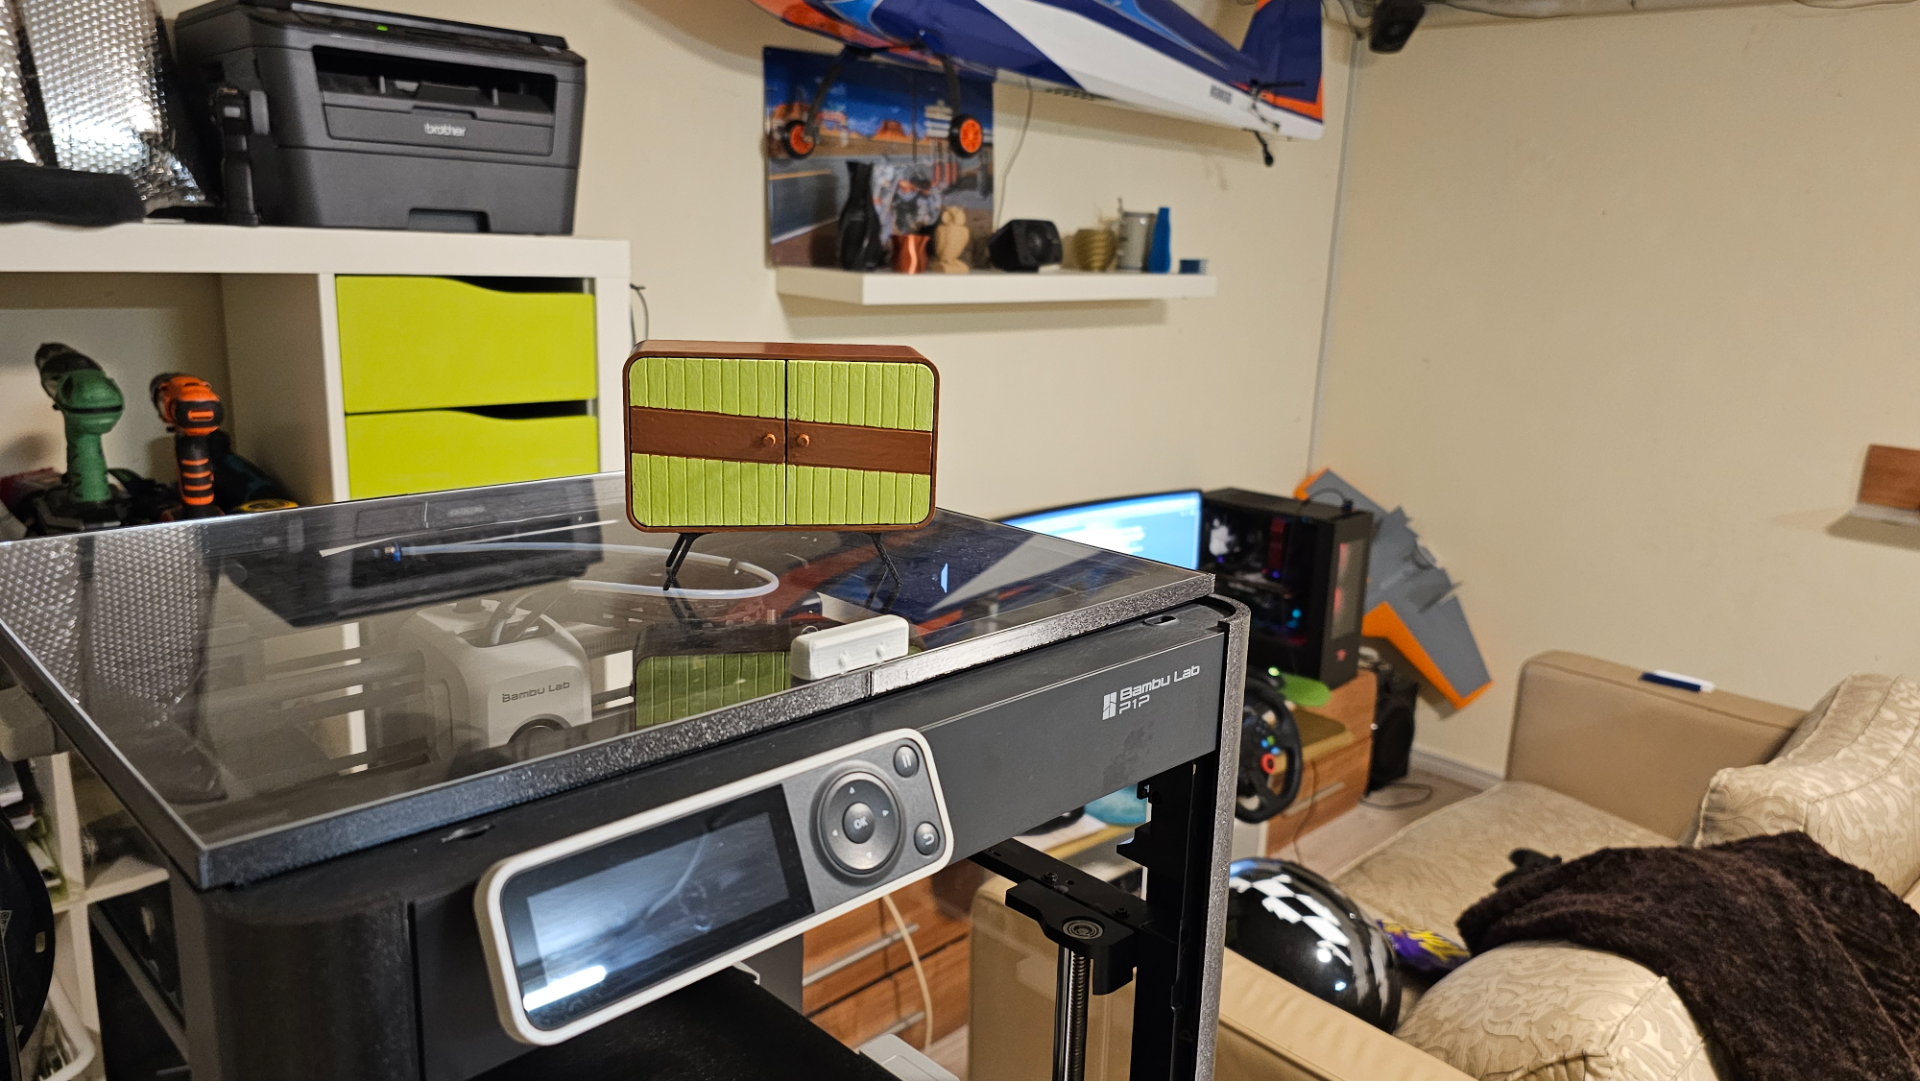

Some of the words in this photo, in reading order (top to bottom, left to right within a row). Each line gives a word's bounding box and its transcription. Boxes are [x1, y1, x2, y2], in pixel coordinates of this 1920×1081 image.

[424, 122, 466, 137] brother
[502, 687, 545, 703] Bambu
[548, 681, 570, 692] Lab
[1120, 675, 1171, 702] Bambu
[1173, 665, 1200, 683] Lab
[1119, 694, 1150, 715] P1P
[853, 816, 869, 830] OK
